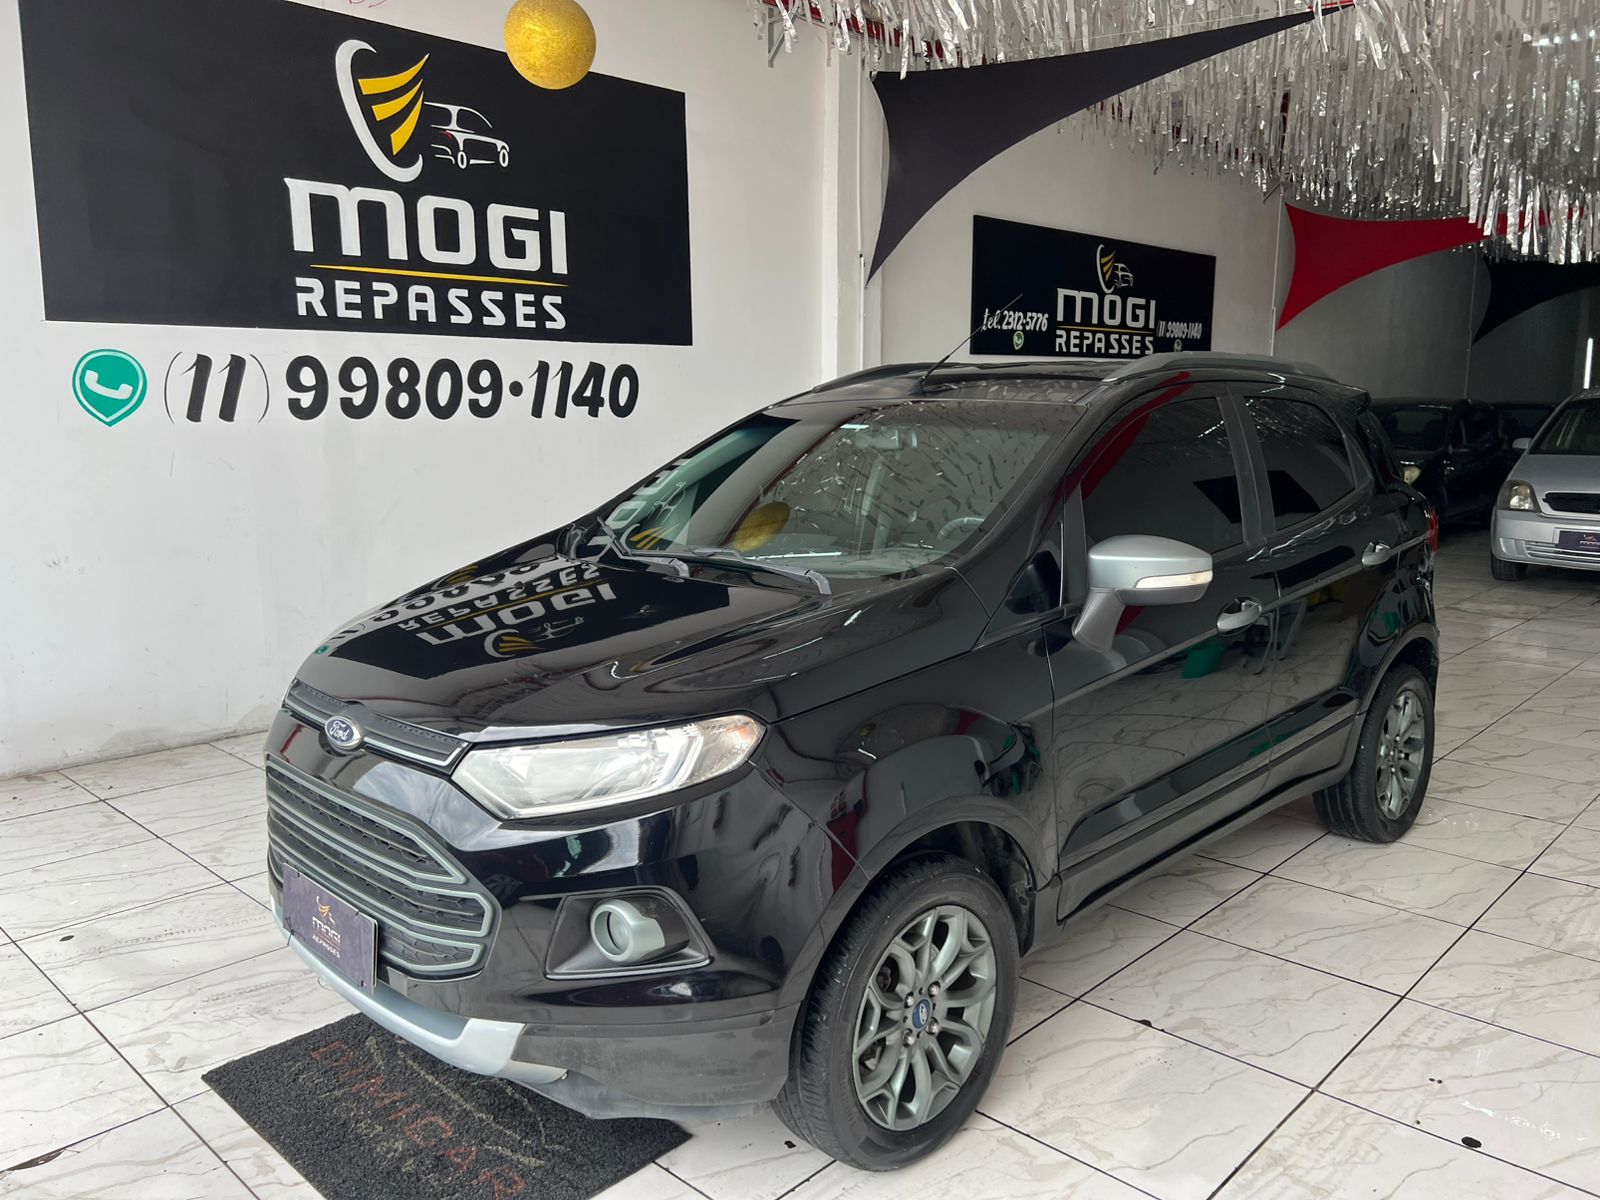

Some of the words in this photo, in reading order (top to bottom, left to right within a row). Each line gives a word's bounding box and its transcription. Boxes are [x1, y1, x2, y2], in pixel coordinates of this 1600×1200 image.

[283, 177, 568, 275] MOGI
[295, 276, 566, 330] REPASSES
[1057, 287, 1156, 329] MOGI
[1055, 329, 1154, 355] REPASSES
[164, 351, 270, 425] (11)
[330, 720, 350, 740] Ford
